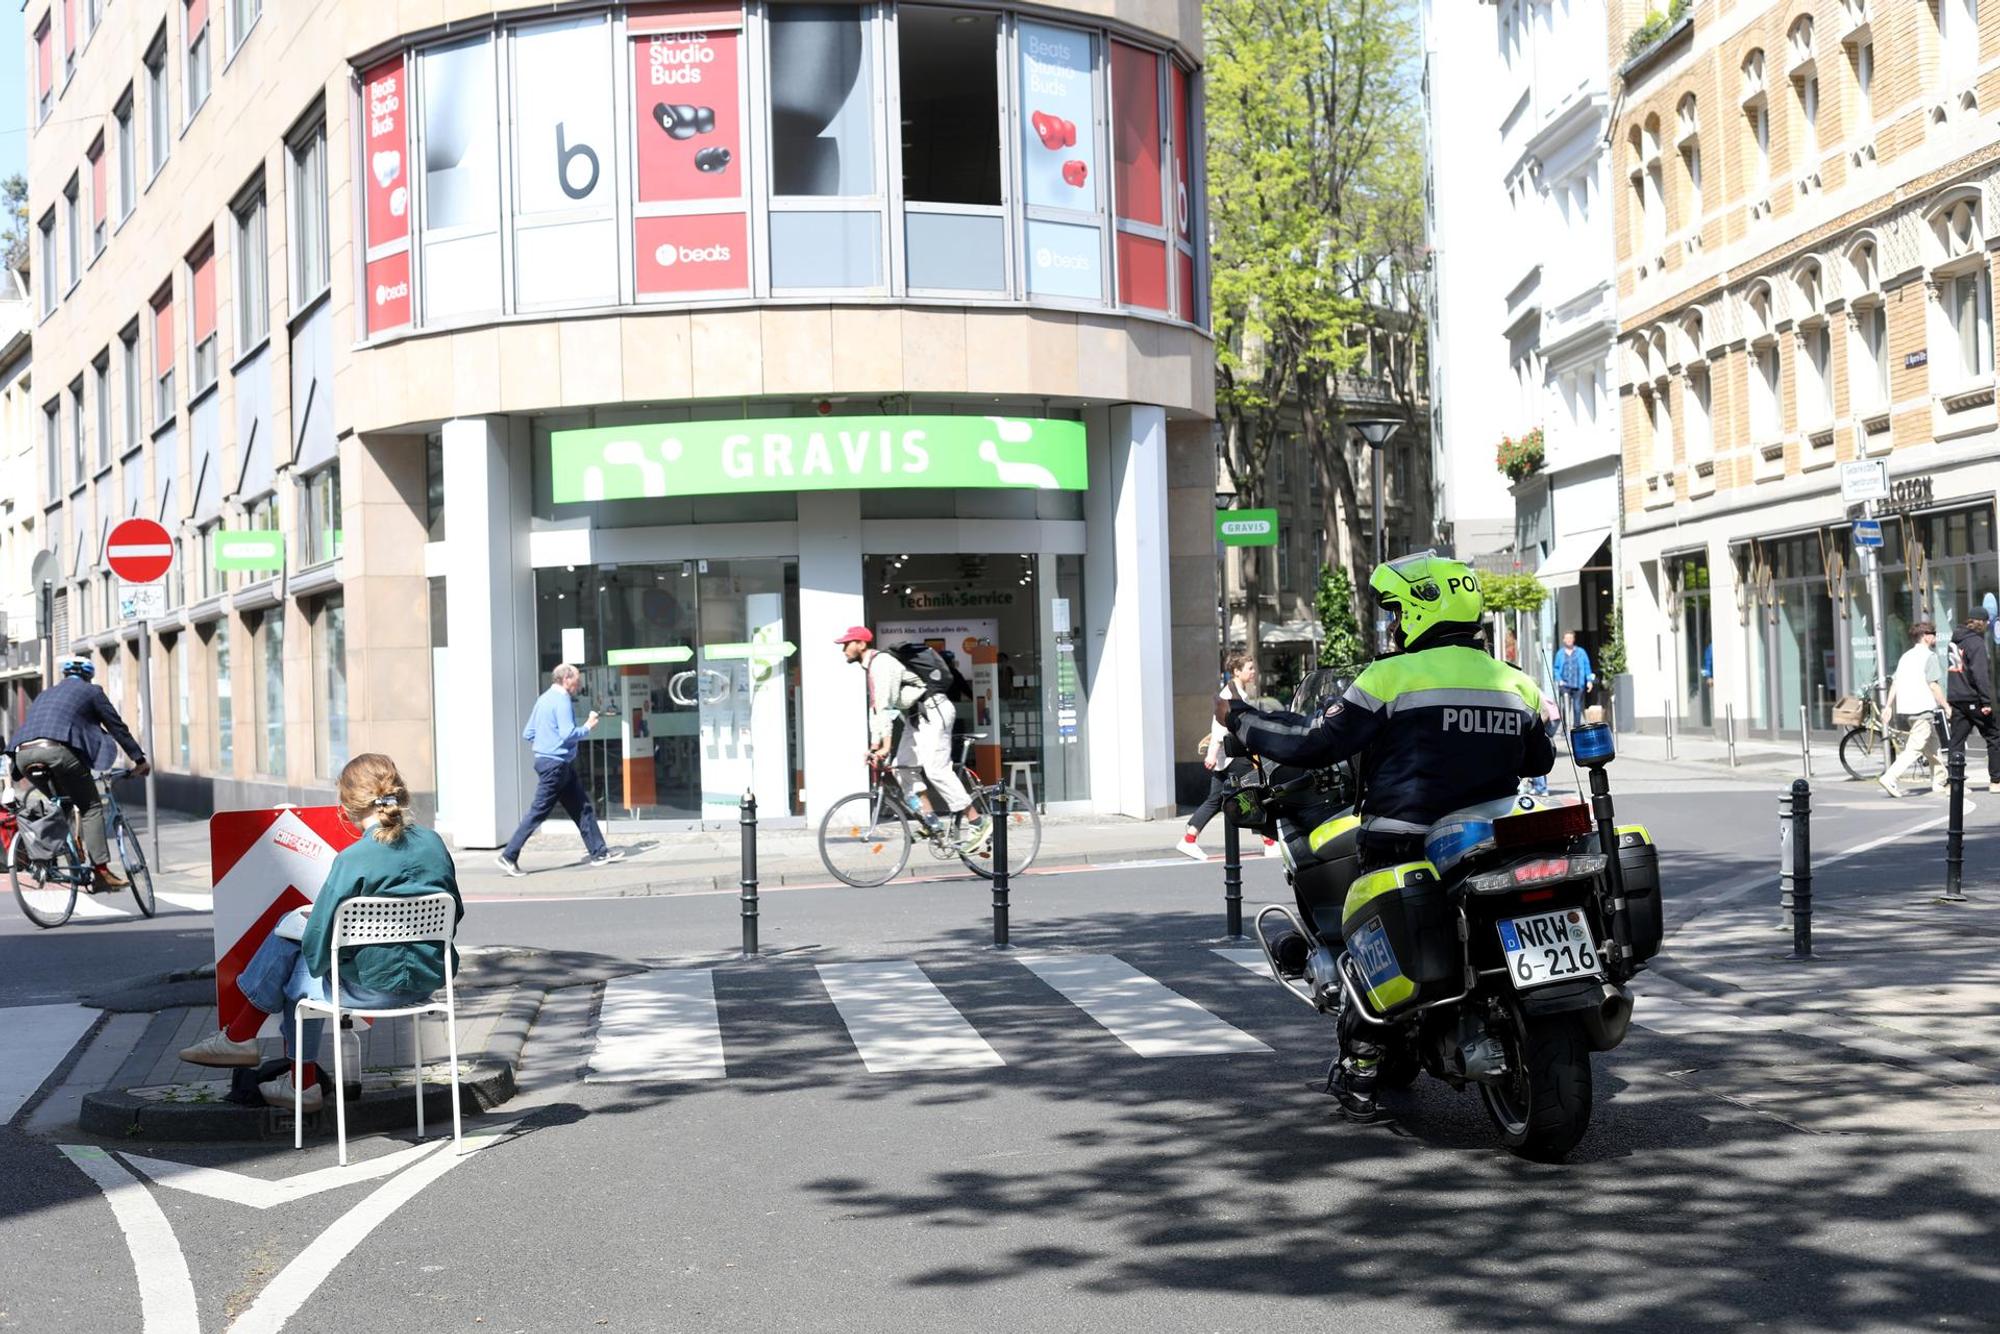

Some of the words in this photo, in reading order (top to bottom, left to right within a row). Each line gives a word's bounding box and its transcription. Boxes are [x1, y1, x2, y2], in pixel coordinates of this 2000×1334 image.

[649, 44, 714, 65] Studio
[1029, 35, 1071, 60] Beats
[651, 64, 702, 85] Buds
[1030, 72, 1067, 96] Buds
[371, 77, 397, 101] Beats
[371, 94, 400, 118] Studio
[371, 114, 395, 138] Buds
[555, 121, 600, 200] b
[679, 243, 731, 263] beats
[1053, 250, 1090, 271] beats
[385, 280, 408, 301] beats
[721, 429, 930, 479] GRAVIS
[1227, 523, 1265, 532] GRAVIS
[898, 591, 1013, 608] Technik-Service
[1443, 708, 1521, 735] POLIZEI
[1508, 940, 1515, 948] D
[1515, 915, 1569, 949] NRW
[1516, 943, 1595, 980] 6-216
